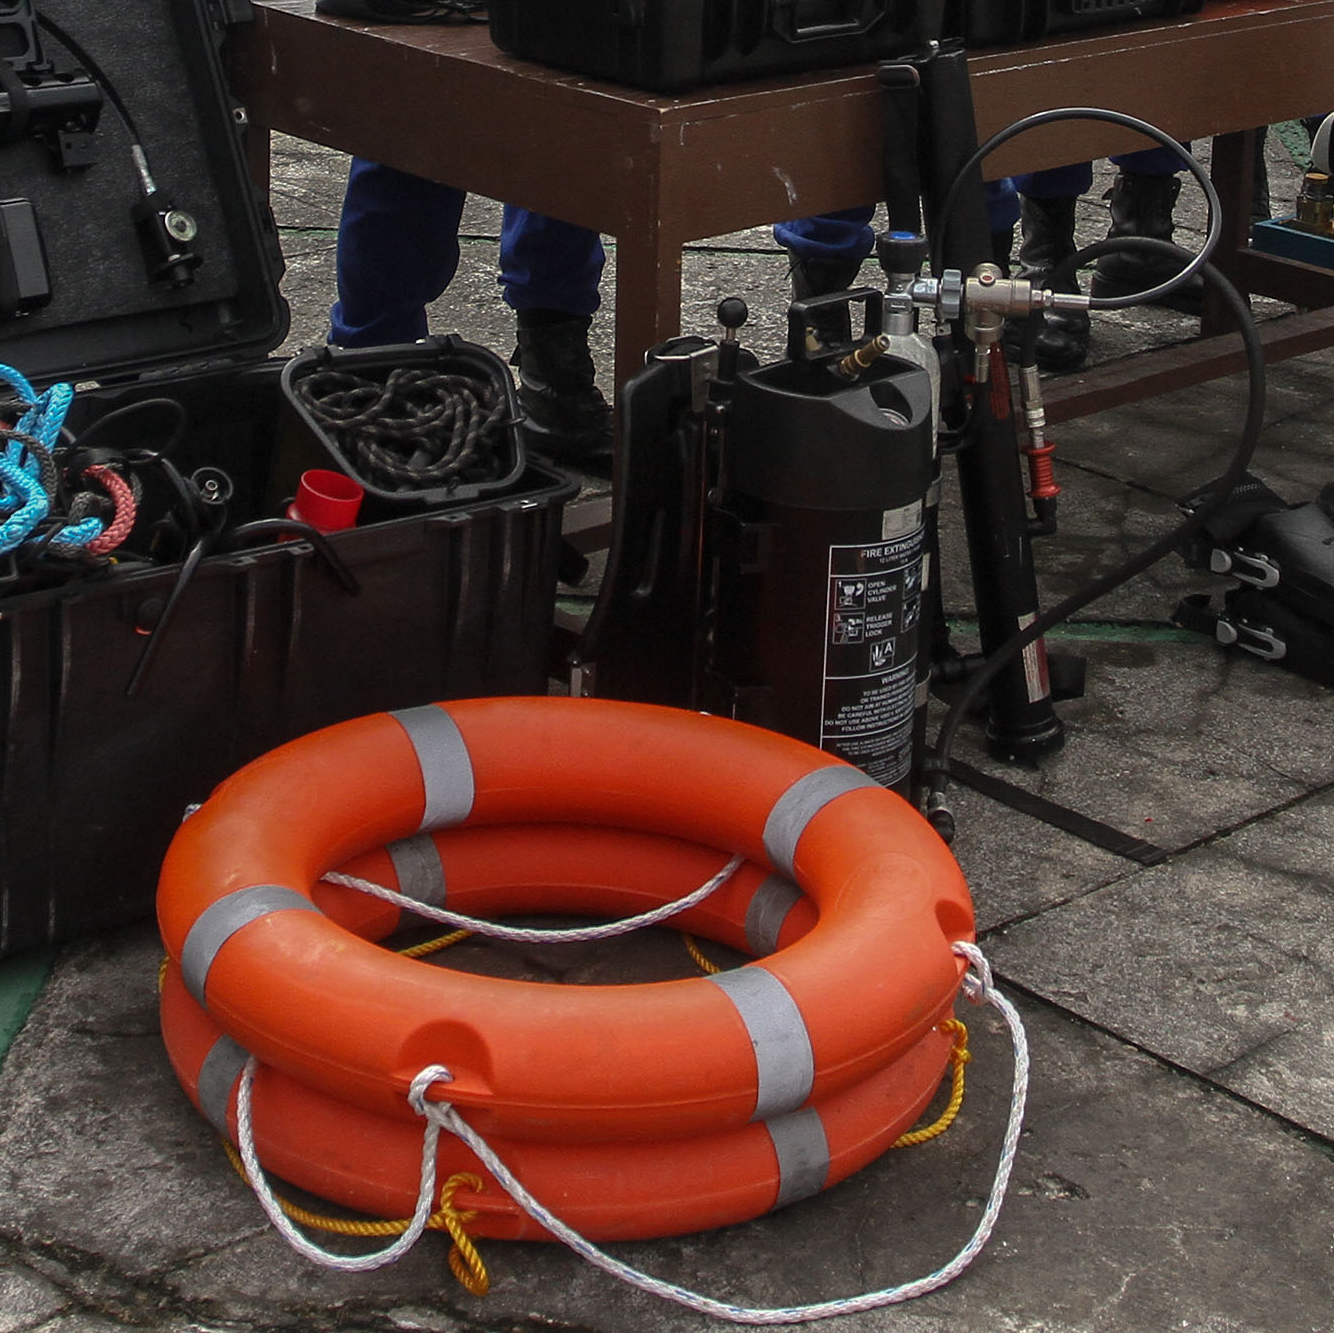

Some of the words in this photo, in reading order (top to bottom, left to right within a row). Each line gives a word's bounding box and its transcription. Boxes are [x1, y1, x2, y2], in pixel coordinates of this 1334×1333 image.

[861, 547, 883, 559] FIRE
[865, 630, 884, 638] LOCK
[884, 642, 893, 654] A
